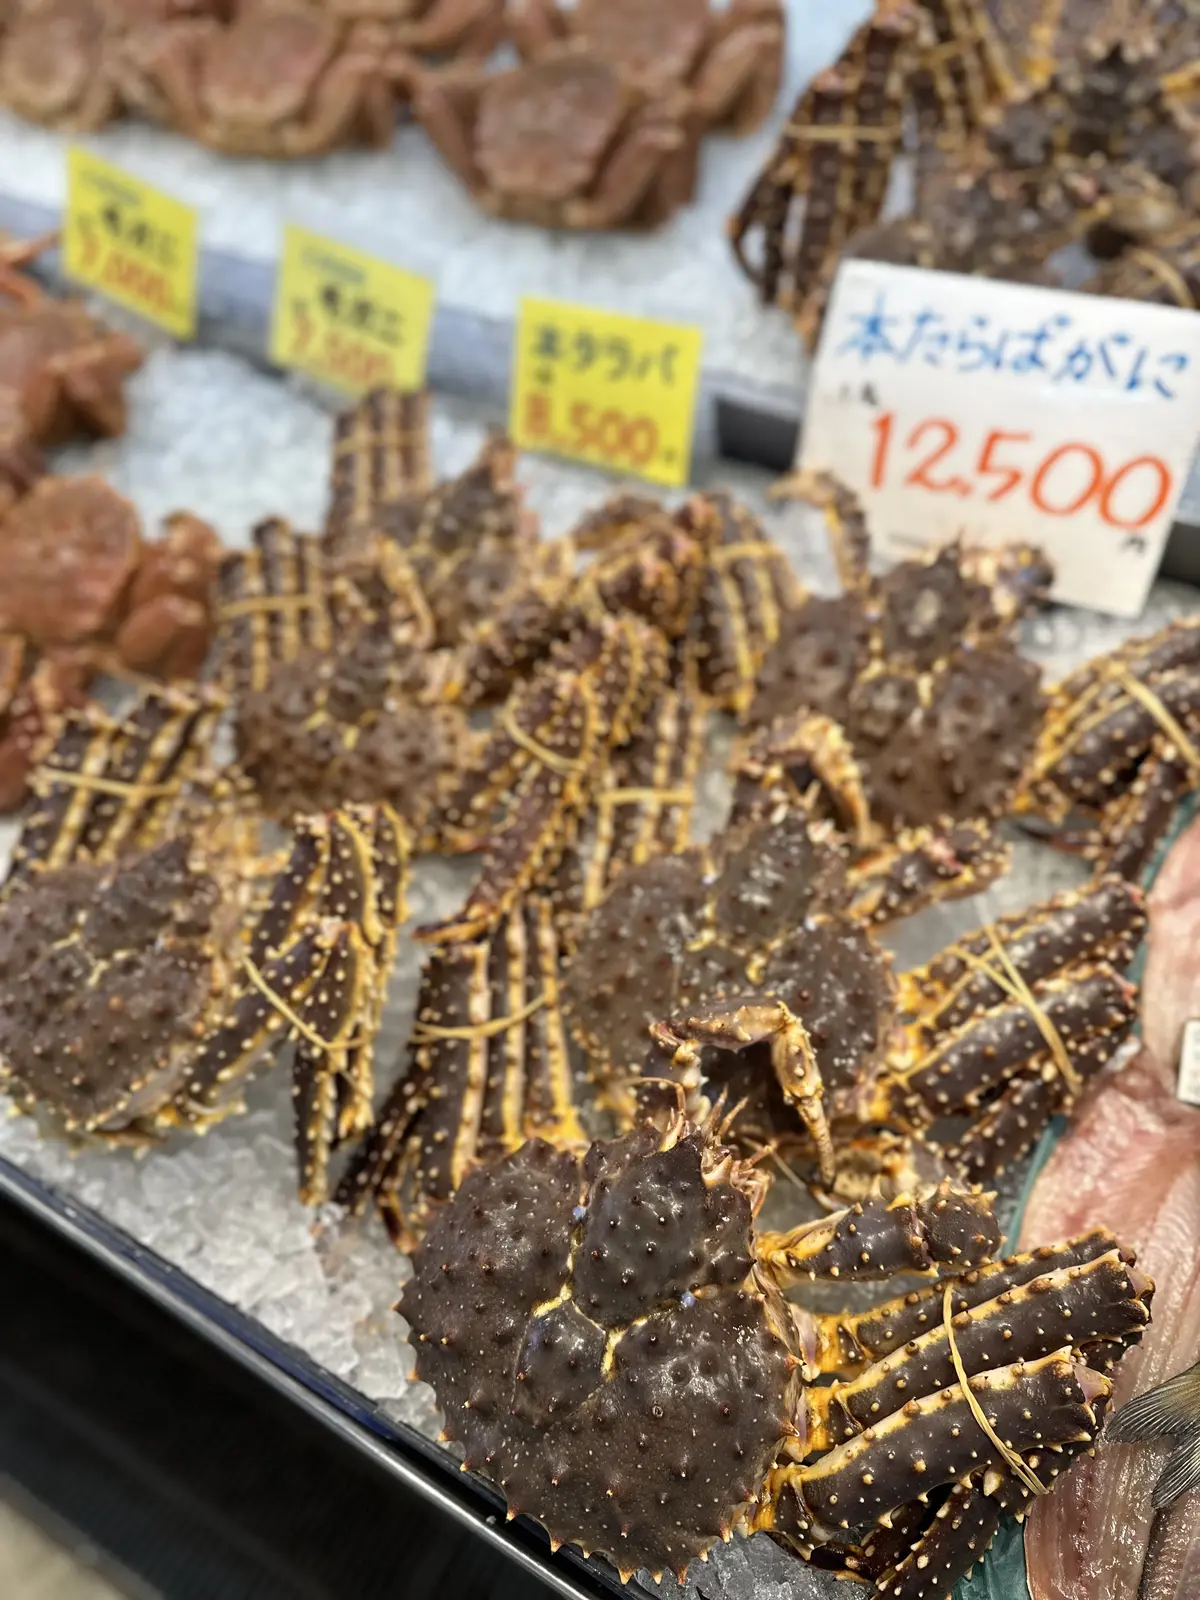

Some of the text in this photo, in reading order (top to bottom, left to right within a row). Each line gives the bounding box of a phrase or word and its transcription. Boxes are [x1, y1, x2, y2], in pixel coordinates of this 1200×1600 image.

[836, 291, 1188, 399] 本たらばがに
[870, 411, 1172, 530] 12,500
